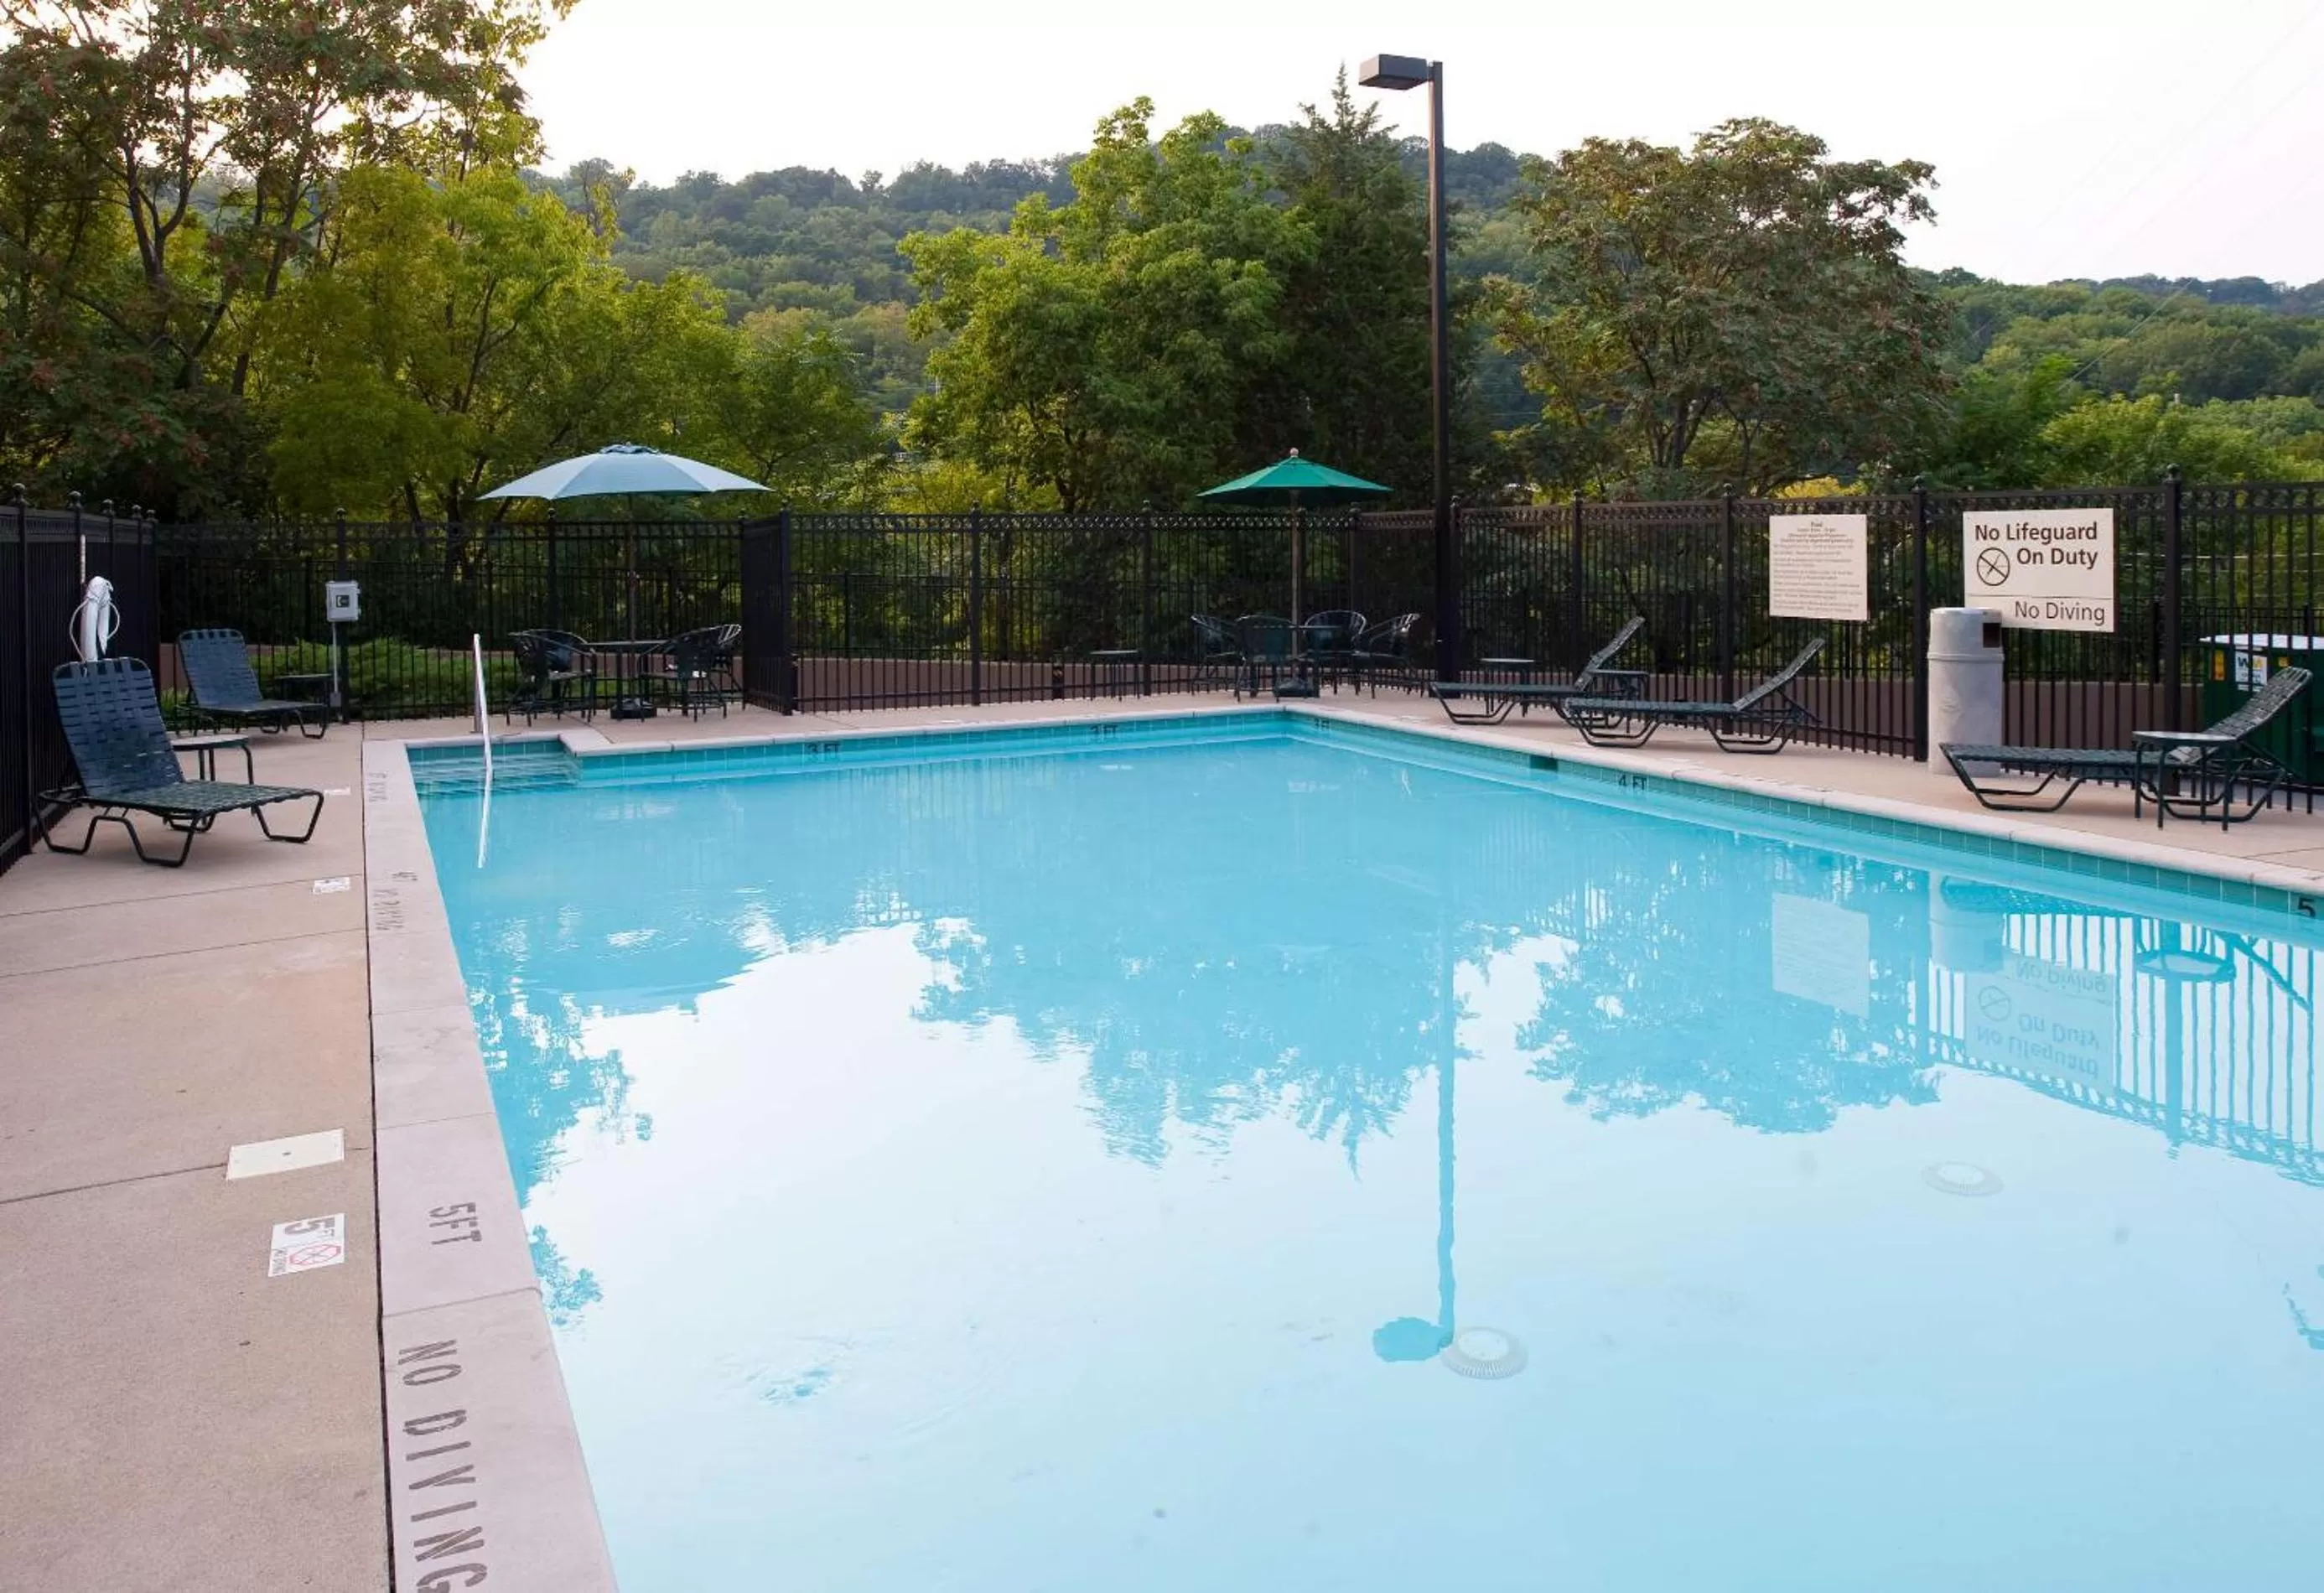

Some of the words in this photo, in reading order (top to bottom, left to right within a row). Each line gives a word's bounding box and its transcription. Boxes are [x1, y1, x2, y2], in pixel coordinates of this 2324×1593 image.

[1974, 524, 2000, 541] No
[2006, 521, 2098, 546] Lifeguard
[2016, 547, 2044, 565] On
[2051, 547, 2098, 570] Duty
[2015, 600, 2040, 619] No
[2046, 601, 2105, 626] Diving
[2298, 897, 2316, 919] 5
[397, 1339, 462, 1387] NO
[402, 1409, 488, 1593] DIVING
